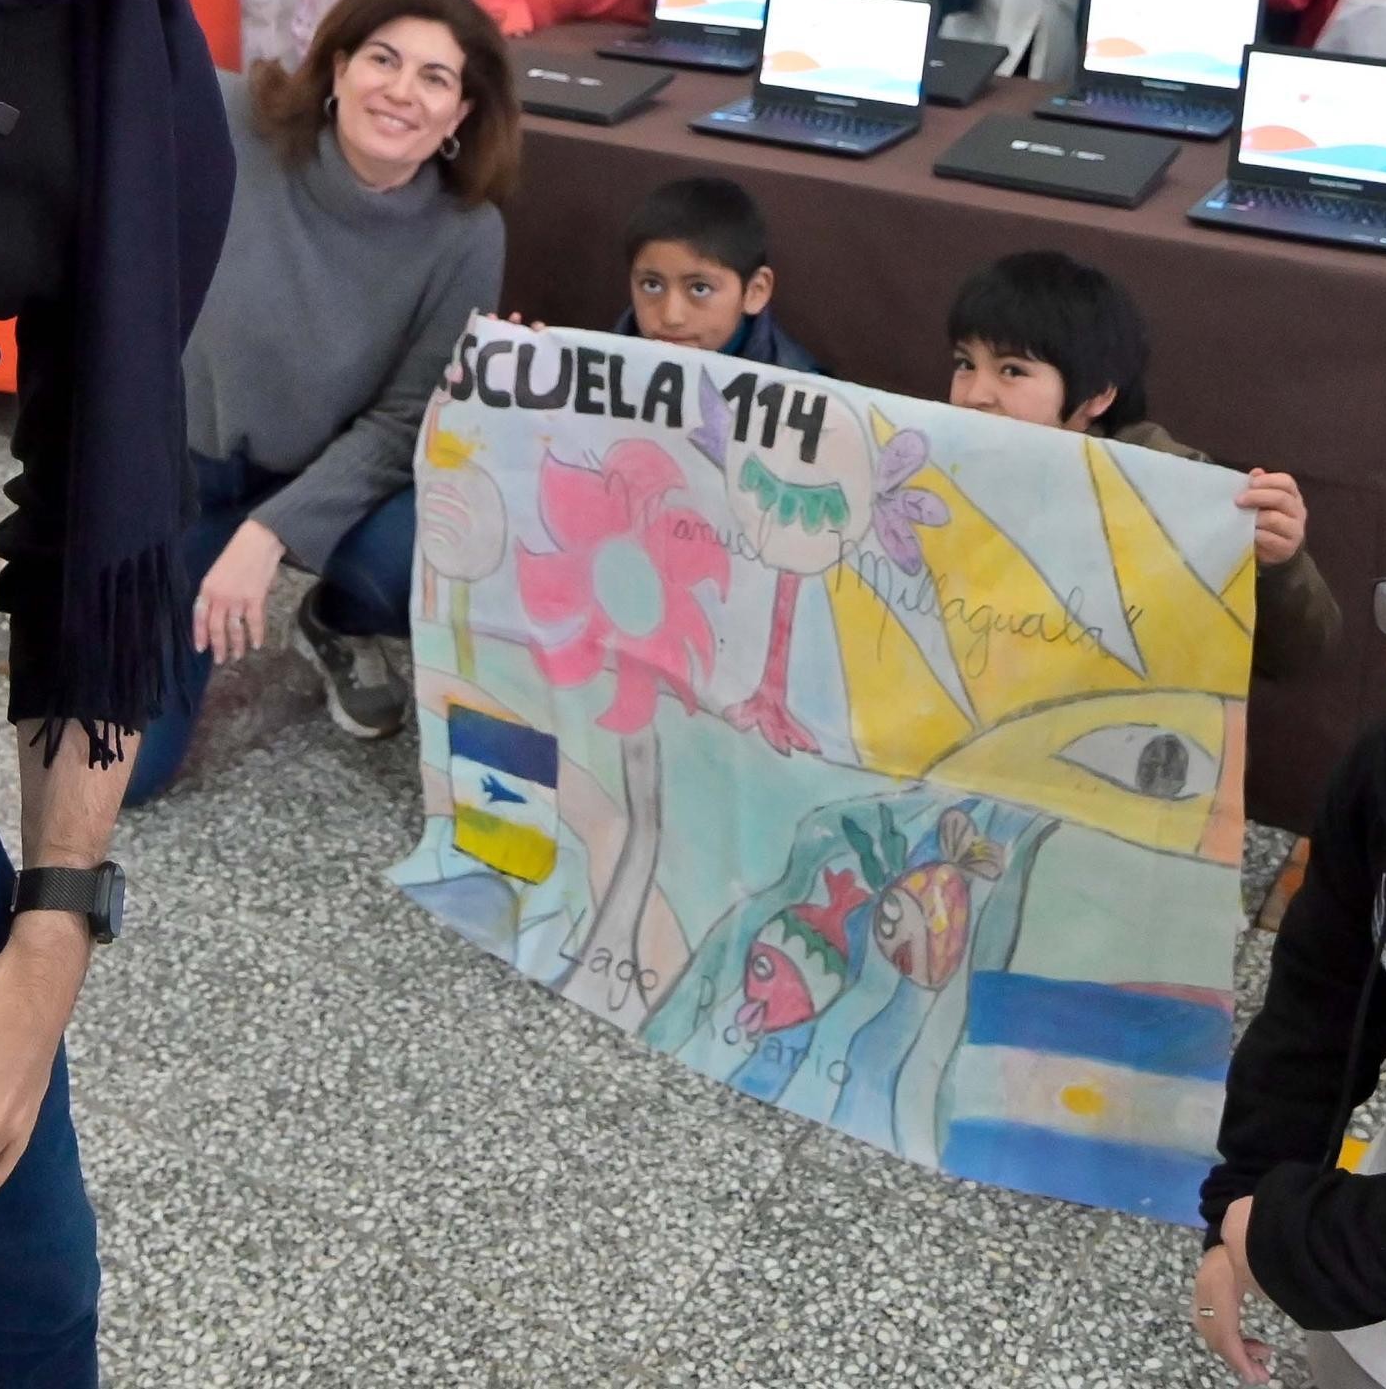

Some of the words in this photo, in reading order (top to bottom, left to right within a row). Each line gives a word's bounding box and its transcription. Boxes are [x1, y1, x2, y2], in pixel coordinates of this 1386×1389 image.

[440, 332, 685, 428] SCUELA
[722, 372, 828, 464] 114
[558, 907, 659, 1012] Lago
[692, 974, 852, 1086] Rosario
